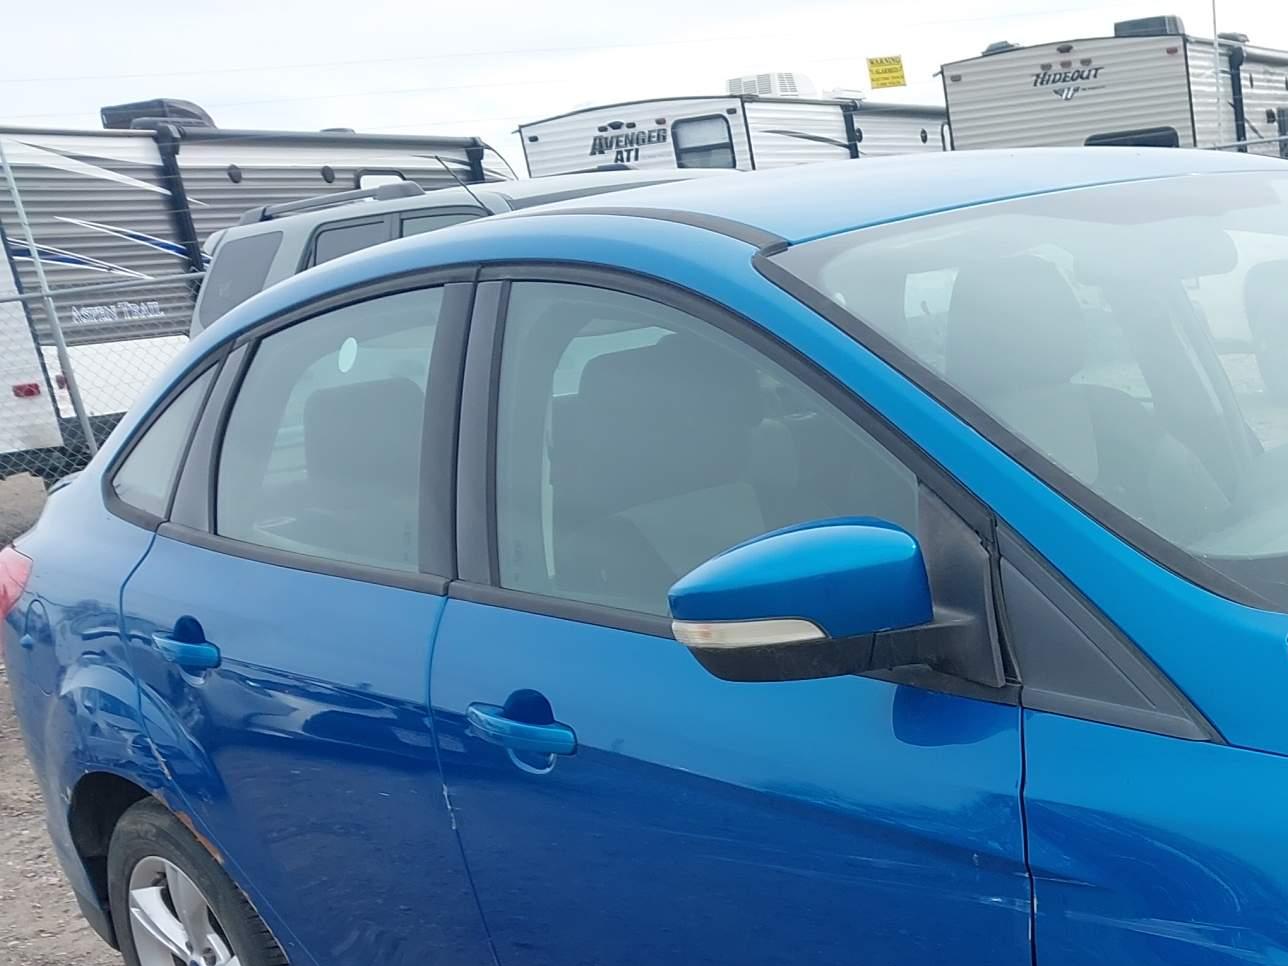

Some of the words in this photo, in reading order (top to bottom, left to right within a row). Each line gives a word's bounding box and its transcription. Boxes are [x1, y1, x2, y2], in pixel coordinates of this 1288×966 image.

[1032, 67, 1104, 87] HIDEOUT
[589, 128, 667, 156] AVENGER
[614, 147, 639, 163] ATI
[71, 305, 118, 324] ASPEN
[117, 302, 165, 320] TRAIL
